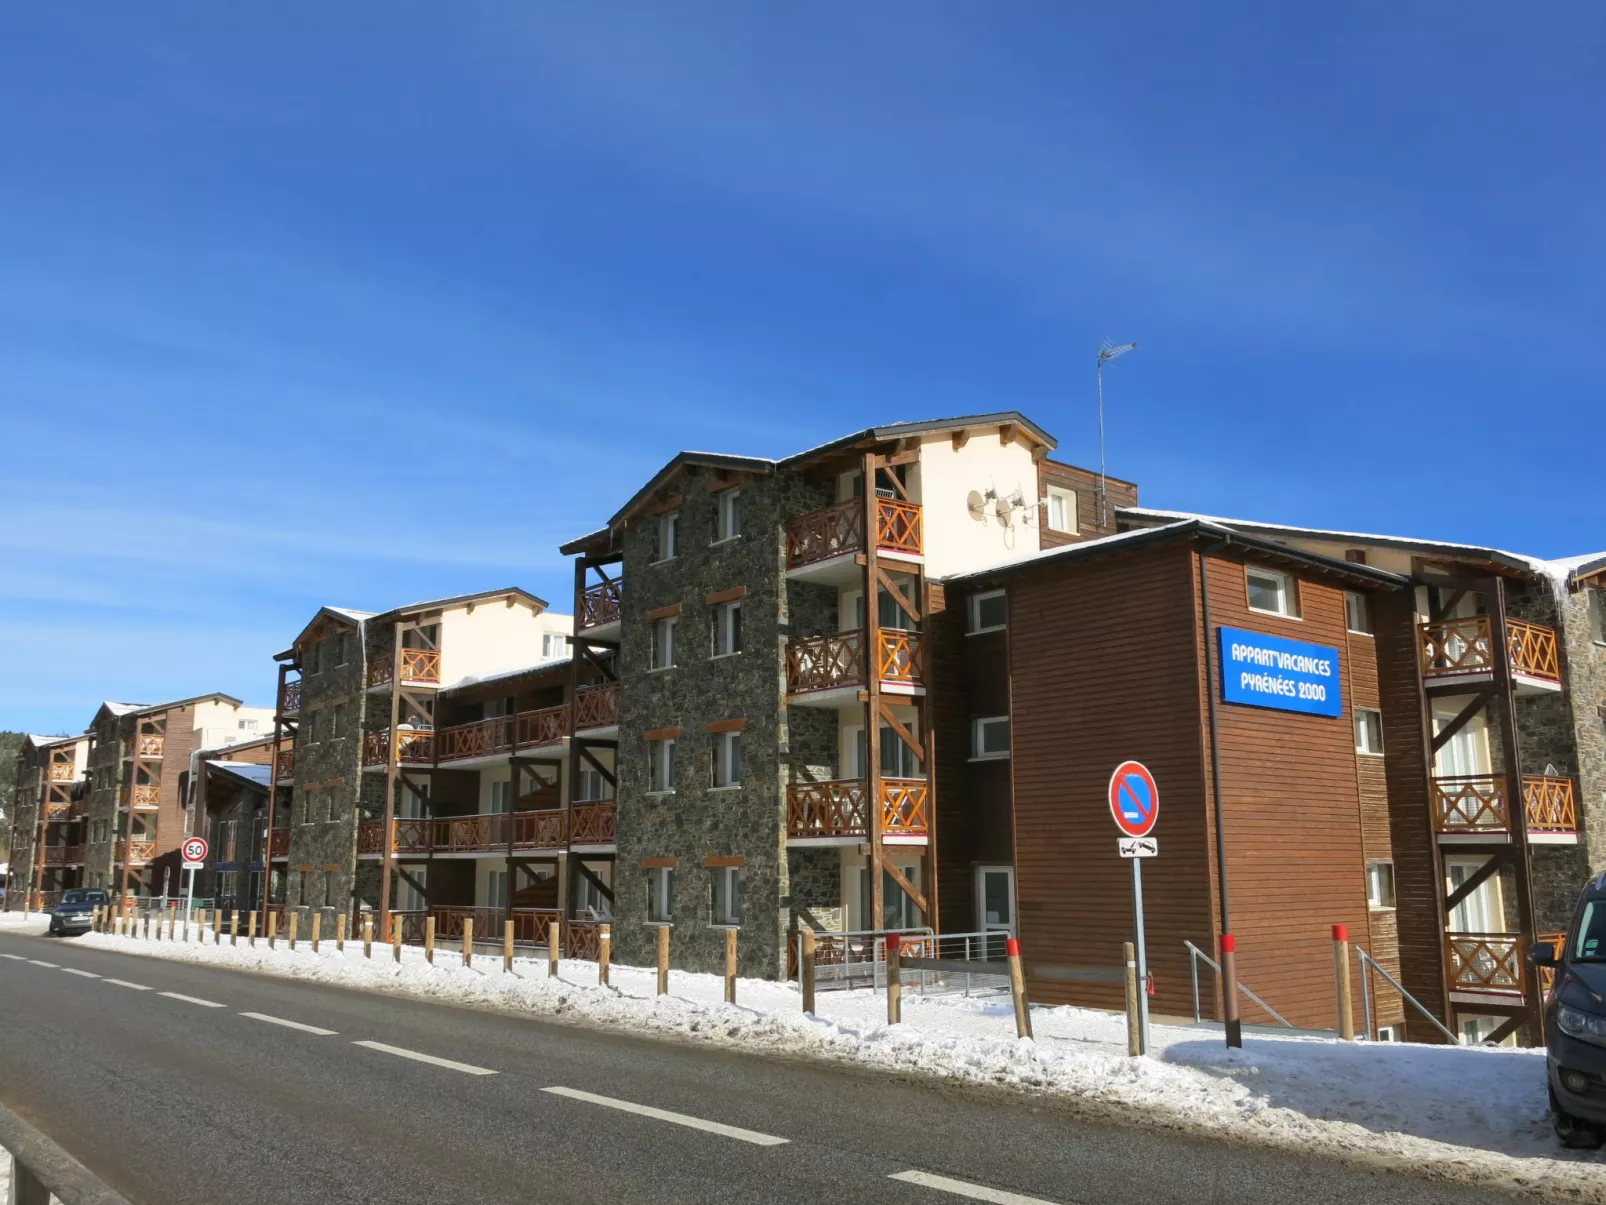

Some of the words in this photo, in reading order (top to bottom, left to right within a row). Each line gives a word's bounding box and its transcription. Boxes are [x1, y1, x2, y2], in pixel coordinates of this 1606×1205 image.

[1231, 643, 1331, 676] APPART'VACANCES
[1241, 672, 1296, 697] PYRÉNÉES
[1298, 682, 1326, 701] 2000
[187, 845, 202, 855] 50
